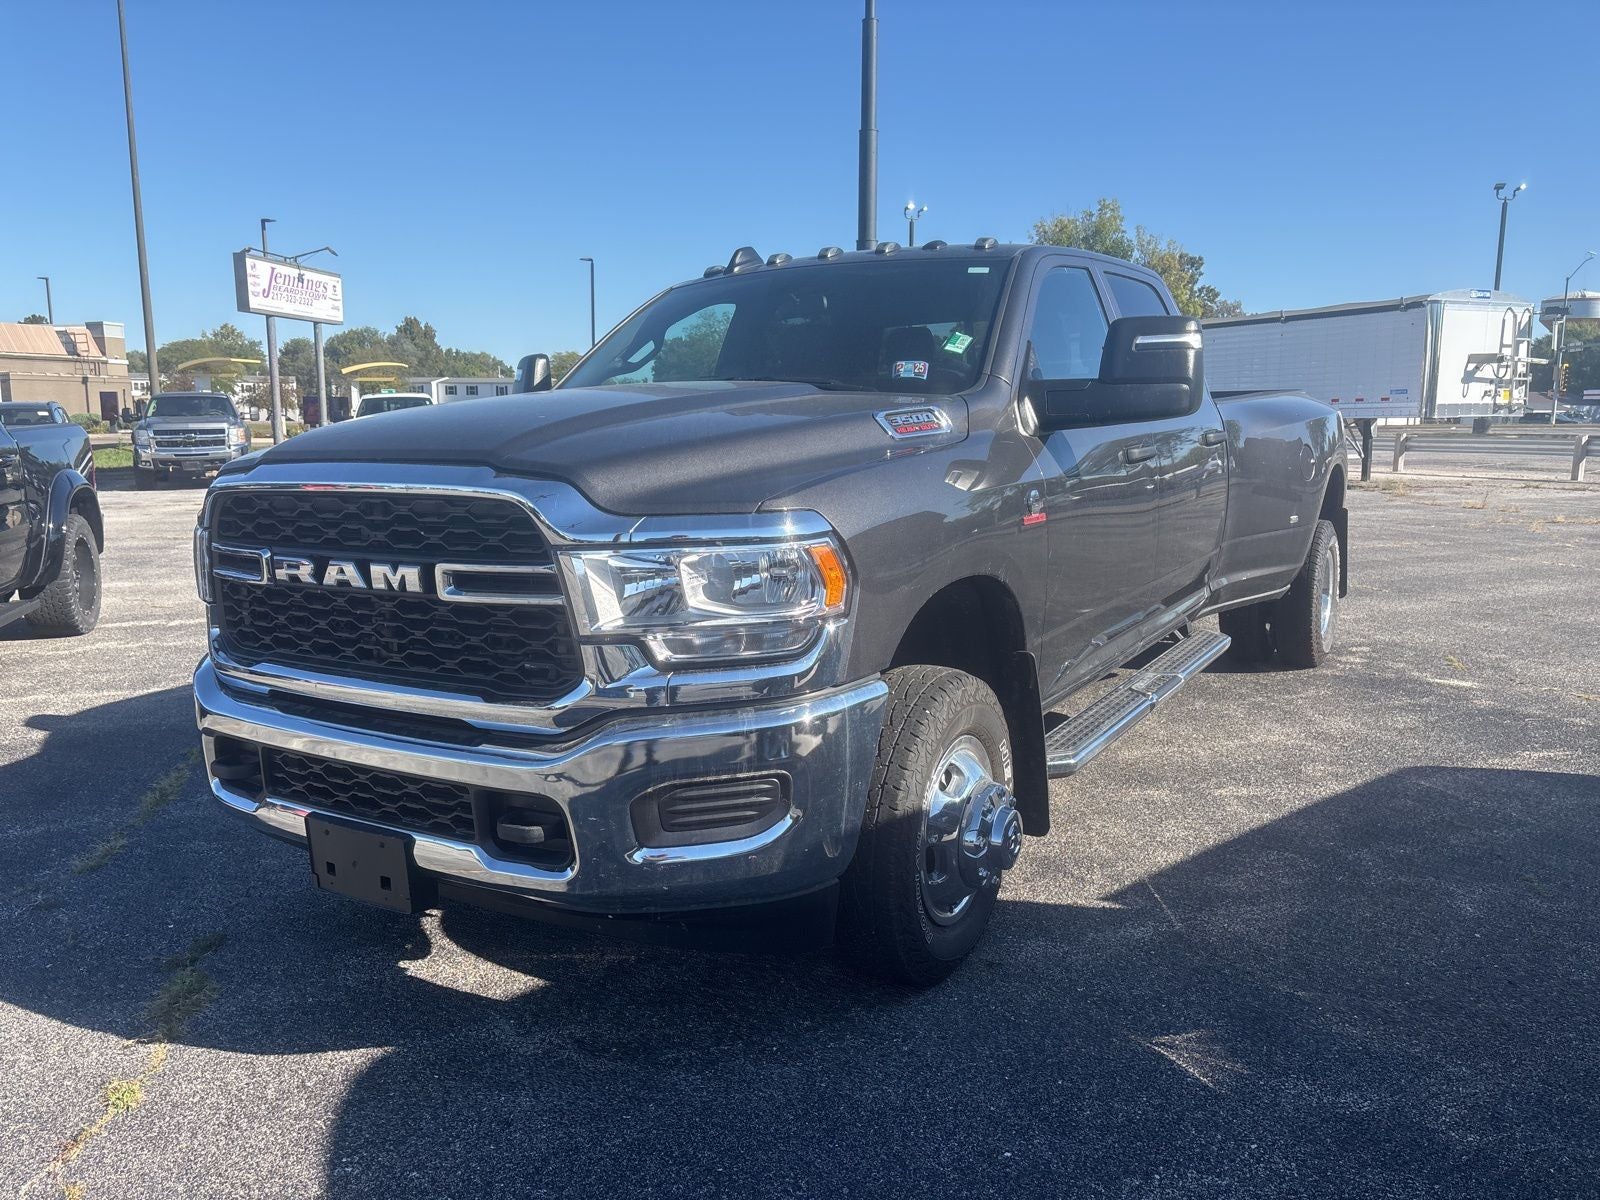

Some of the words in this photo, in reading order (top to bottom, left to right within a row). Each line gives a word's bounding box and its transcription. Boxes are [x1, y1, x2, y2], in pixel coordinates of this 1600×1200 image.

[272, 285, 327, 300] BEARDSTOWN
[914, 363, 924, 373] 25
[890, 413, 932, 426] 3500
[273, 555, 423, 593] RAM
